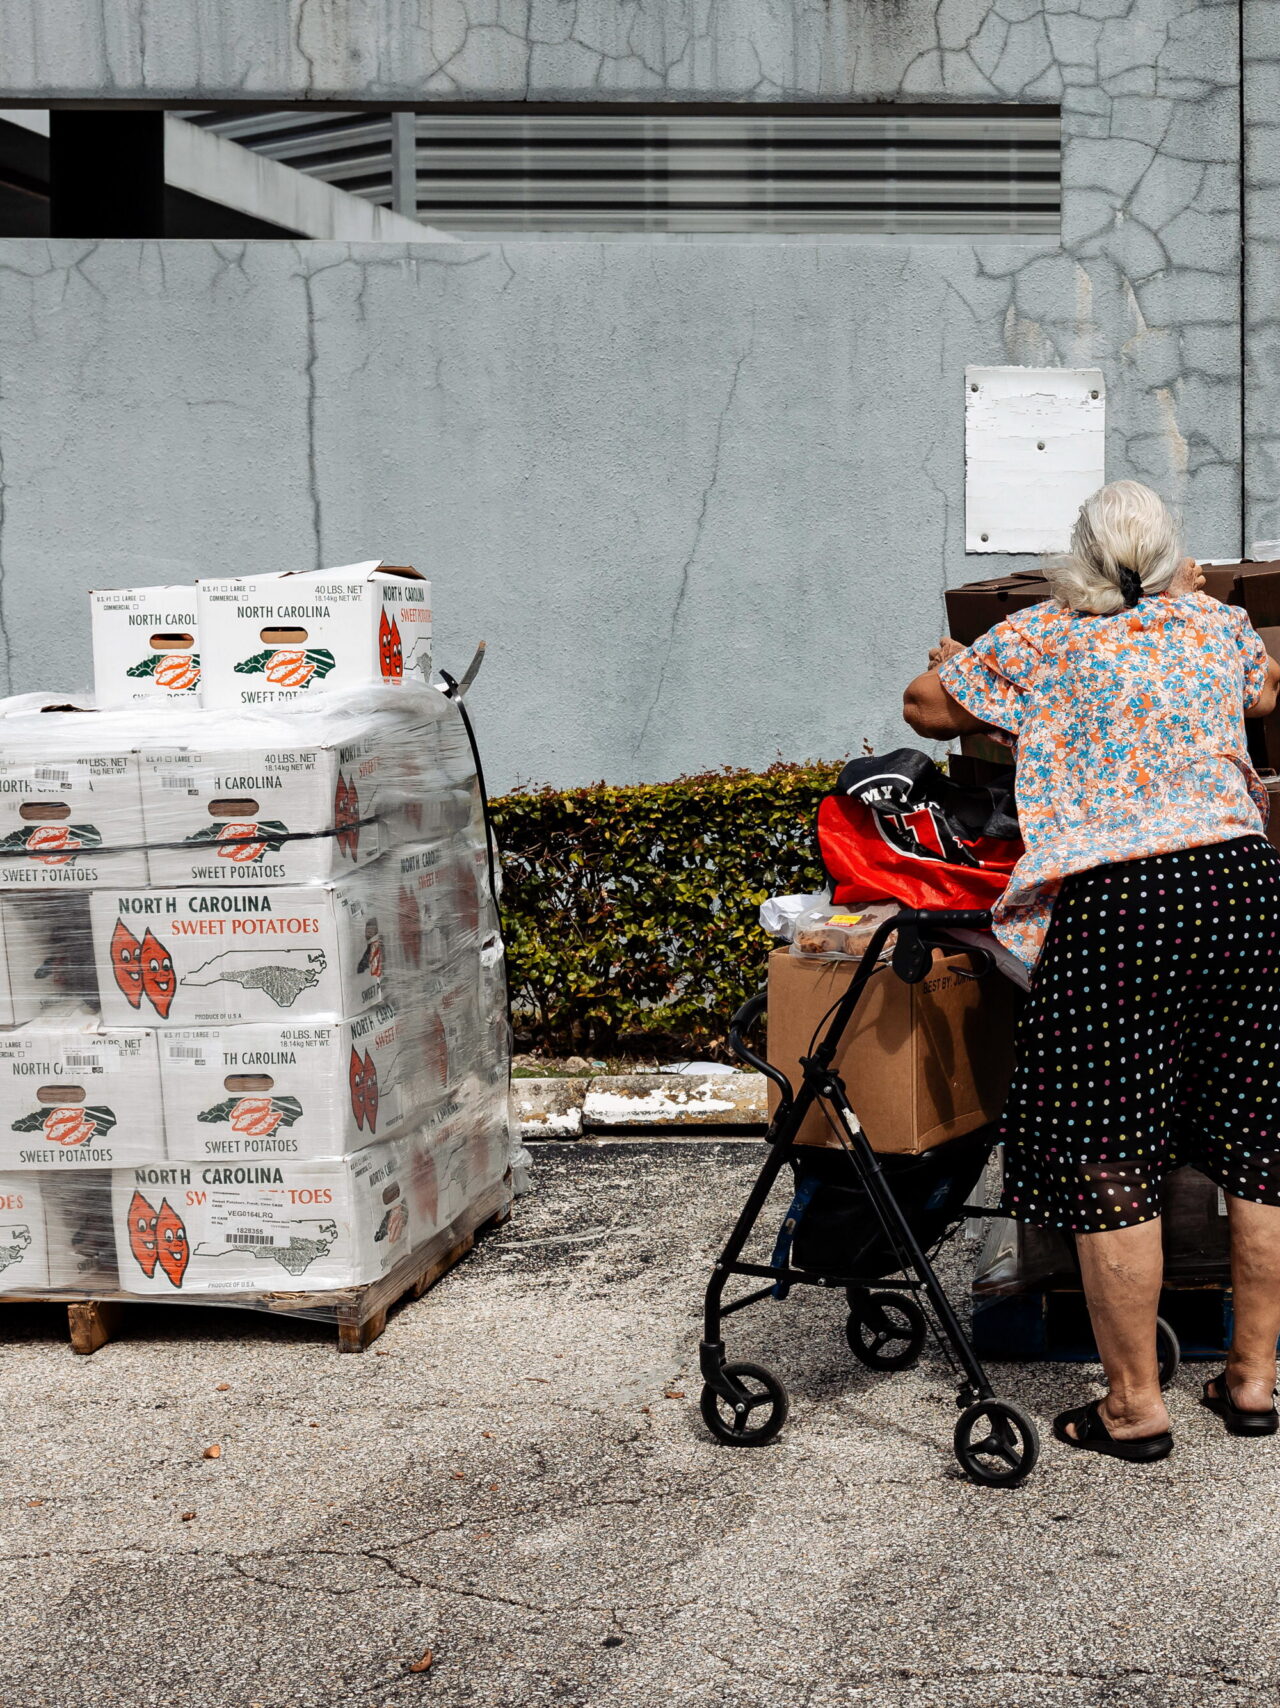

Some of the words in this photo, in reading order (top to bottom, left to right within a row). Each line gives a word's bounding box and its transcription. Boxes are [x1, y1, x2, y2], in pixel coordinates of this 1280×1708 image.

[315, 586, 326, 594] 40
[327, 586, 345, 594] LBS.
[347, 585, 363, 594] NET
[382, 586, 402, 602] NORTH
[237, 606, 273, 618] NORTH
[277, 606, 331, 618] CAROLINA
[128, 614, 162, 626] NORTH
[90, 758, 109, 767] LBS.
[111, 758, 128, 767] NET
[265, 754, 276, 763] 40
[278, 753, 297, 763] LBS.
[300, 753, 317, 762] NET
[265, 764, 290, 773] 18.14kg
[225, 776, 282, 789] CAROLINA
[861, 786, 893, 805] MY
[2, 869, 38, 882] SWEET
[43, 868, 98, 881] POTATOES
[192, 866, 226, 878] SWEET
[230, 864, 285, 878] POTATOES
[119, 897, 177, 914] NORTH
[188, 895, 272, 913] CAROLINA
[171, 919, 226, 936] SWEET
[231, 918, 319, 935] POTATOES
[280, 1031, 292, 1039] 40
[293, 1031, 312, 1039] LBS.
[314, 1030, 331, 1039] NET
[351, 1015, 375, 1041] NORTH
[124, 1039, 142, 1048] NET
[241, 1052, 297, 1065] CAROLINA
[13, 1062, 50, 1075] NORTH
[205, 1141, 240, 1154] SWEET
[244, 1140, 298, 1153] POTATOES
[19, 1150, 55, 1163] SWEET
[59, 1149, 113, 1162] POTATOES
[135, 1168, 191, 1185] NORTH
[202, 1167, 284, 1184] CAROLINA
